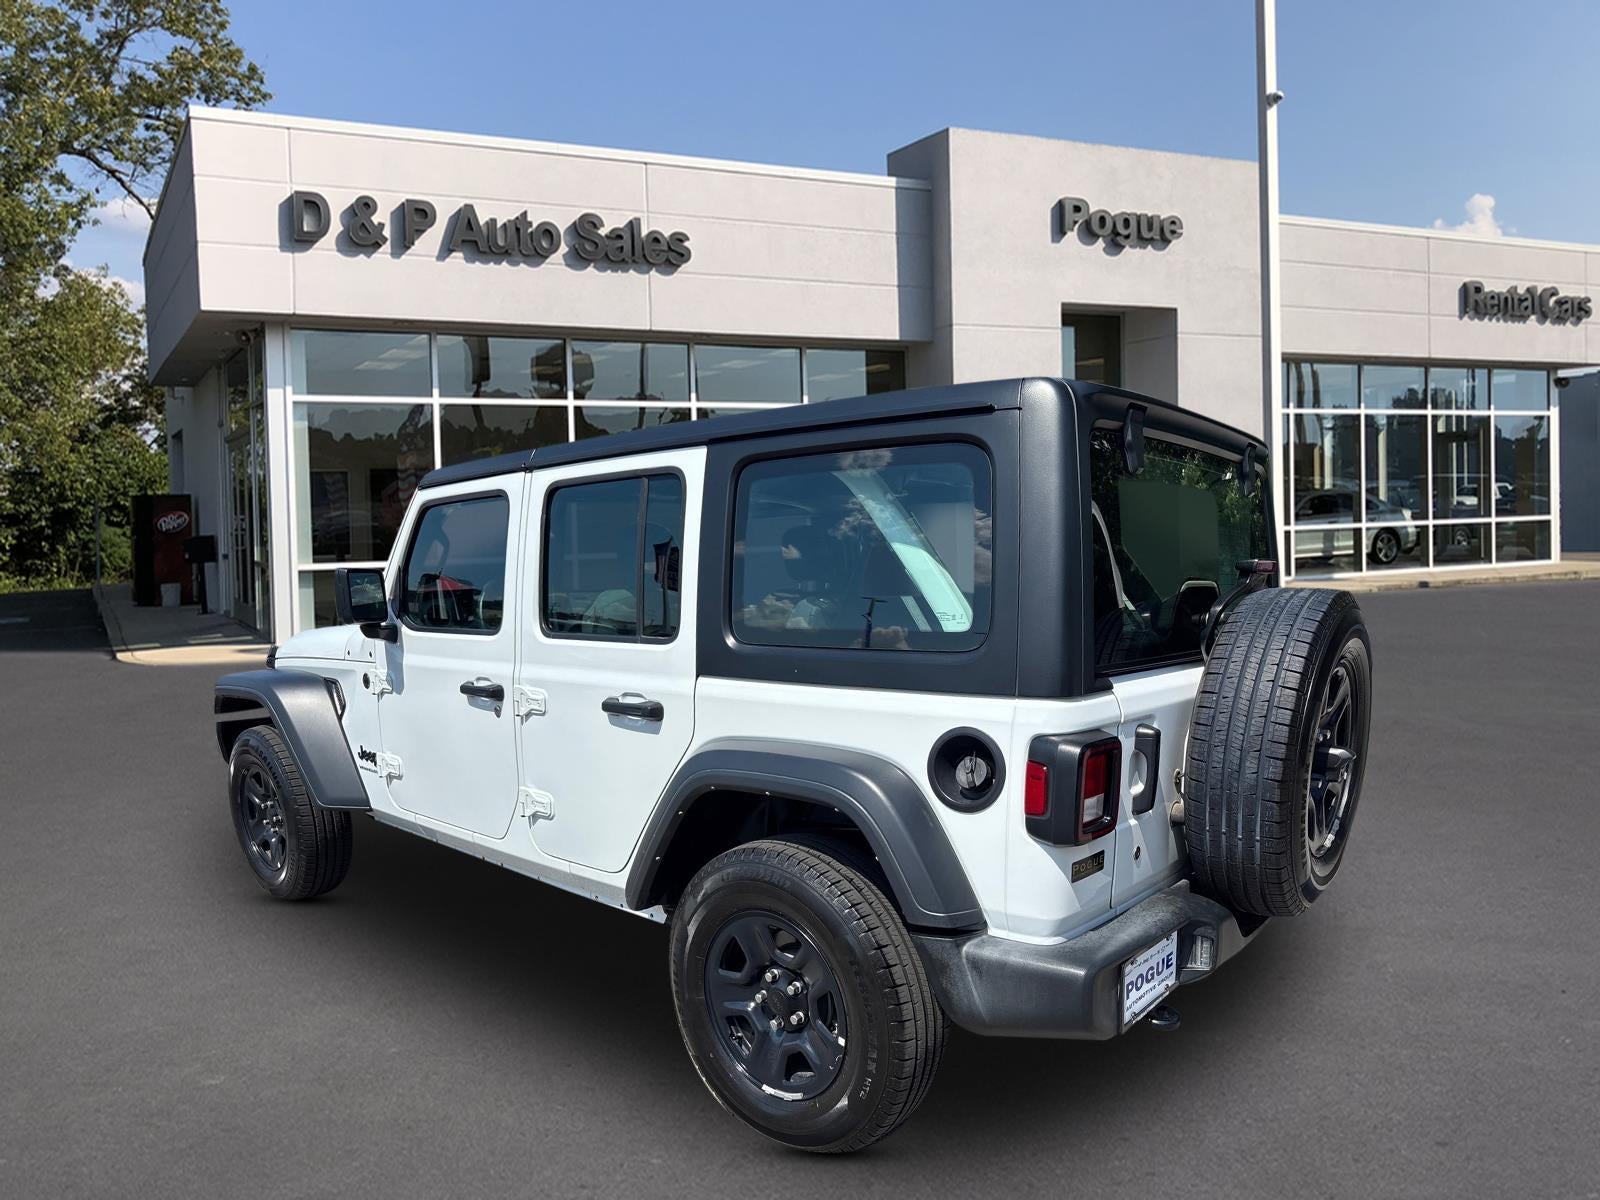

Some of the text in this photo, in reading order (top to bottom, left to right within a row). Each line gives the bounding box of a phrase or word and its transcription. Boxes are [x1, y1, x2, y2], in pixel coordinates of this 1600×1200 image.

[291, 190, 692, 267] D & P Auto Sales
[1059, 197, 1184, 247] Pogue
[1463, 280, 1592, 320] Rental Cars
[1073, 854, 1104, 875] POGUE
[1125, 951, 1174, 1000] POGUE
[1125, 984, 1157, 1012] AUTOMOTIVE
